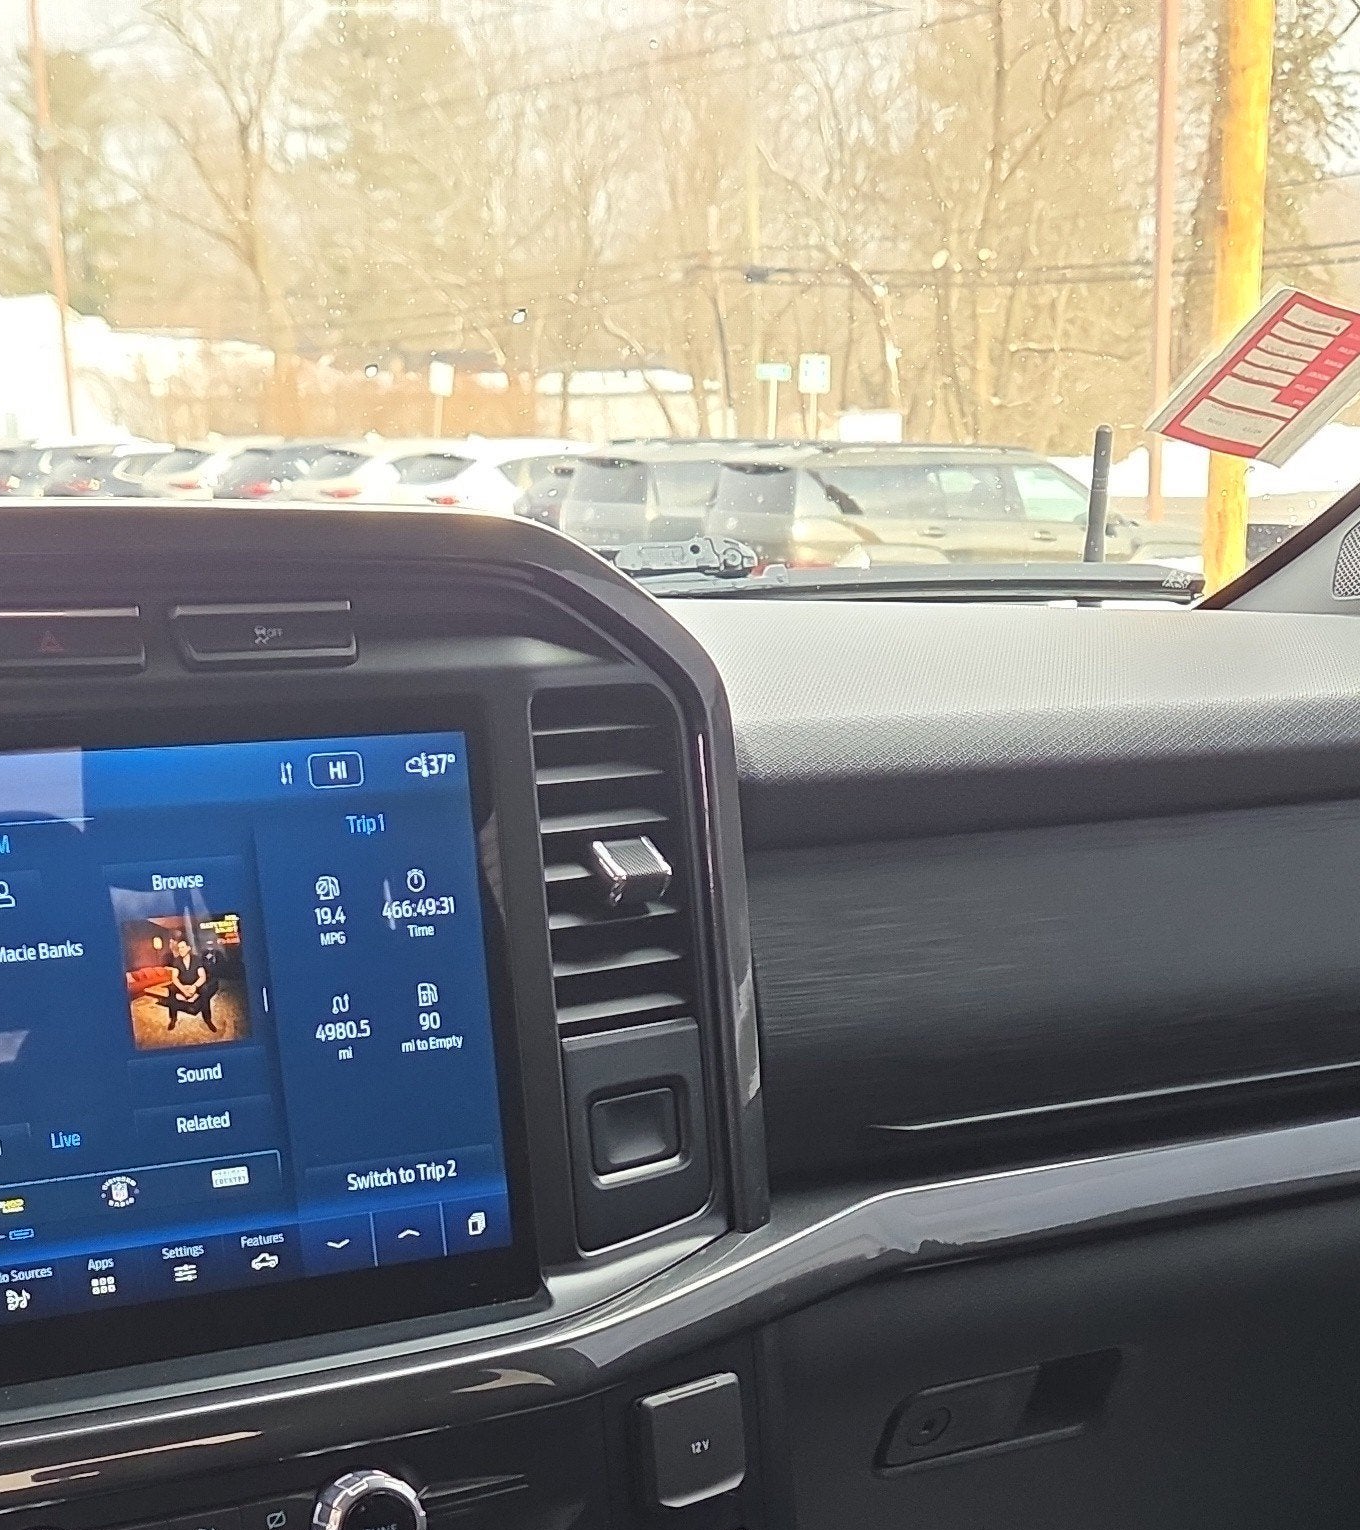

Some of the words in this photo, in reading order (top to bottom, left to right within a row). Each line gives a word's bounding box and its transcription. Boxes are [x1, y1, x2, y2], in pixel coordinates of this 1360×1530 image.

[328, 760, 348, 780] HI
[346, 814, 376, 836] Trip
[377, 814, 386, 832] 1
[151, 872, 204, 892] Browse
[315, 906, 346, 925] 19.4
[382, 896, 456, 920] 466:49:31
[320, 931, 346, 946] MPG
[407, 923, 435, 939] Time
[38, 940, 84, 960] Banks
[315, 1019, 371, 1043] 4980.5
[419, 1013, 441, 1031] 90
[338, 1045, 354, 1060] mi
[401, 1039, 415, 1053] mi
[416, 1038, 428, 1052] to
[429, 1034, 463, 1054] Empty
[176, 1063, 223, 1085] Sound
[176, 1111, 231, 1134] Related
[50, 1130, 81, 1151] Live
[347, 1166, 397, 1191] Switch
[398, 1166, 416, 1184] to
[416, 1161, 446, 1182] Trip
[446, 1159, 458, 1177] 2
[241, 1230, 285, 1248] Features
[161, 1243, 205, 1262] Settings
[10, 1265, 53, 1283] Sources
[87, 1256, 115, 1273] Apps
